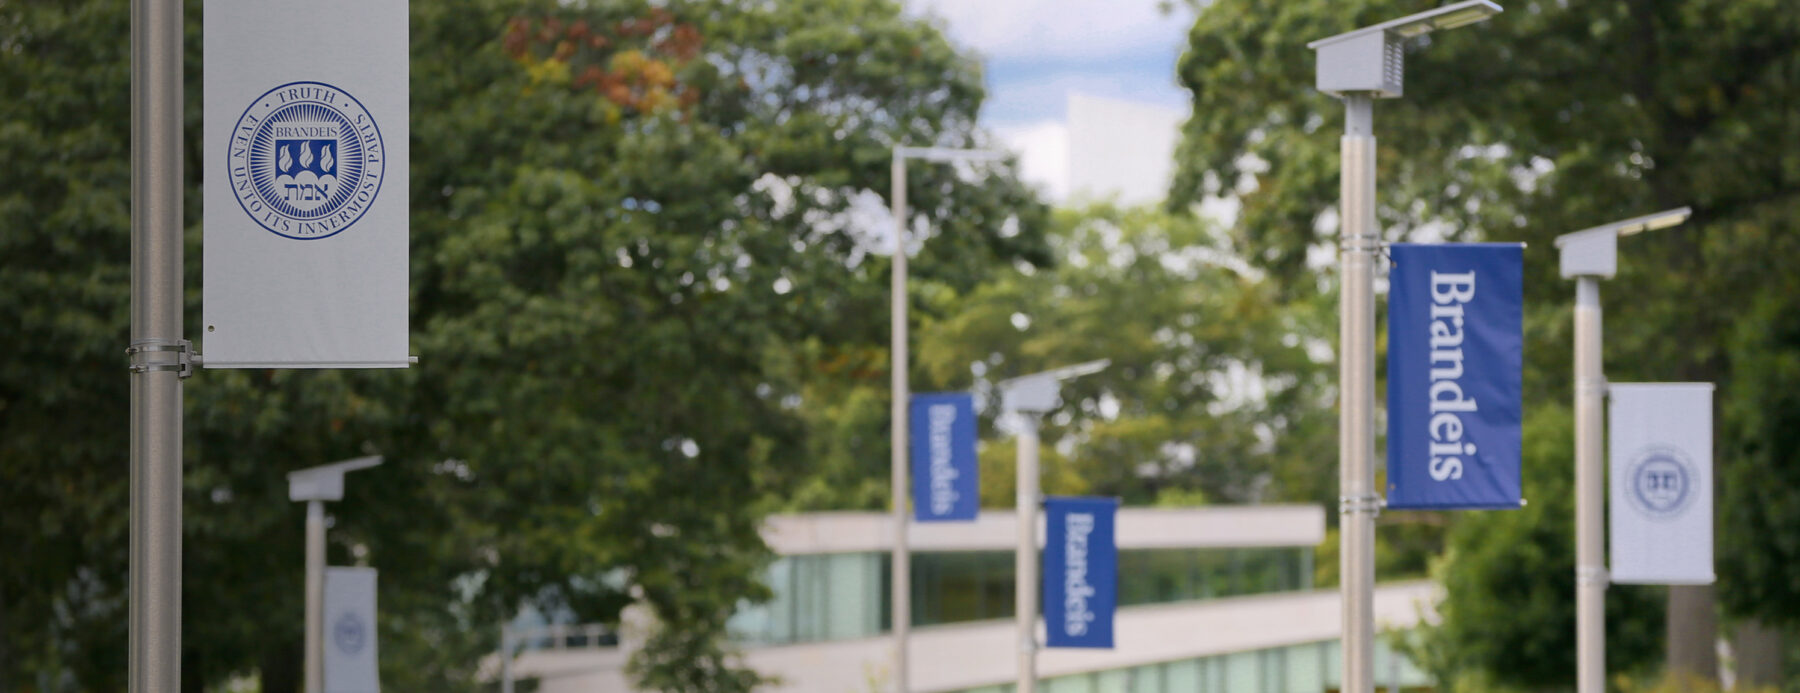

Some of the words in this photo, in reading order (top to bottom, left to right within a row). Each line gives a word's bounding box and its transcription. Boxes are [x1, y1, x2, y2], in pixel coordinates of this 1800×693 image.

[275, 87, 336, 104] TRUTH
[234, 114, 259, 159] EVEN
[276, 126, 338, 138] BRANDEIS
[354, 113, 380, 163] PARTS
[233, 166, 263, 213] UNTO
[284, 183, 329, 201] אמת
[298, 170, 378, 235] INNERMOST
[264, 212, 291, 232] ITS
[1428, 269, 1478, 481] Brandeis
[928, 403, 960, 516] Brandeis
[1064, 512, 1096, 637] Brandeis
